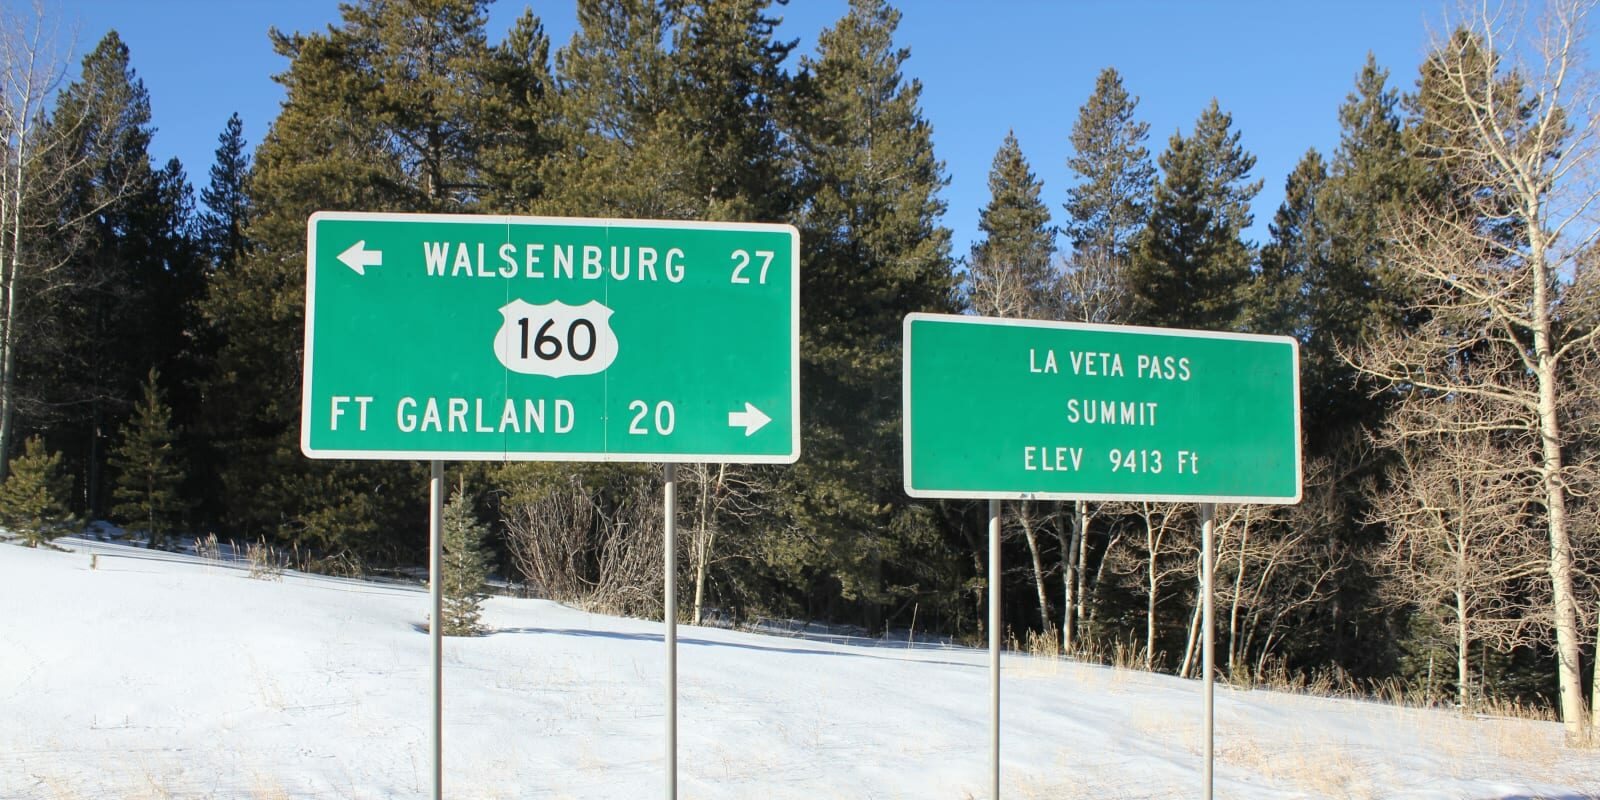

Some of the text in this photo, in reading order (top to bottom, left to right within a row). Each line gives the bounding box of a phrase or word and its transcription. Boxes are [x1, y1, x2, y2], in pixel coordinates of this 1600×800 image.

[424, 242, 774, 283] WALSENBURG 27
[519, 318, 596, 361] 160
[1031, 349, 1190, 380] LA VETA PASS
[331, 396, 674, 435] FT GARLAND 20
[1068, 399, 1157, 425] SUMMIT
[1025, 447, 1198, 474] ELEV 9413 Ft
